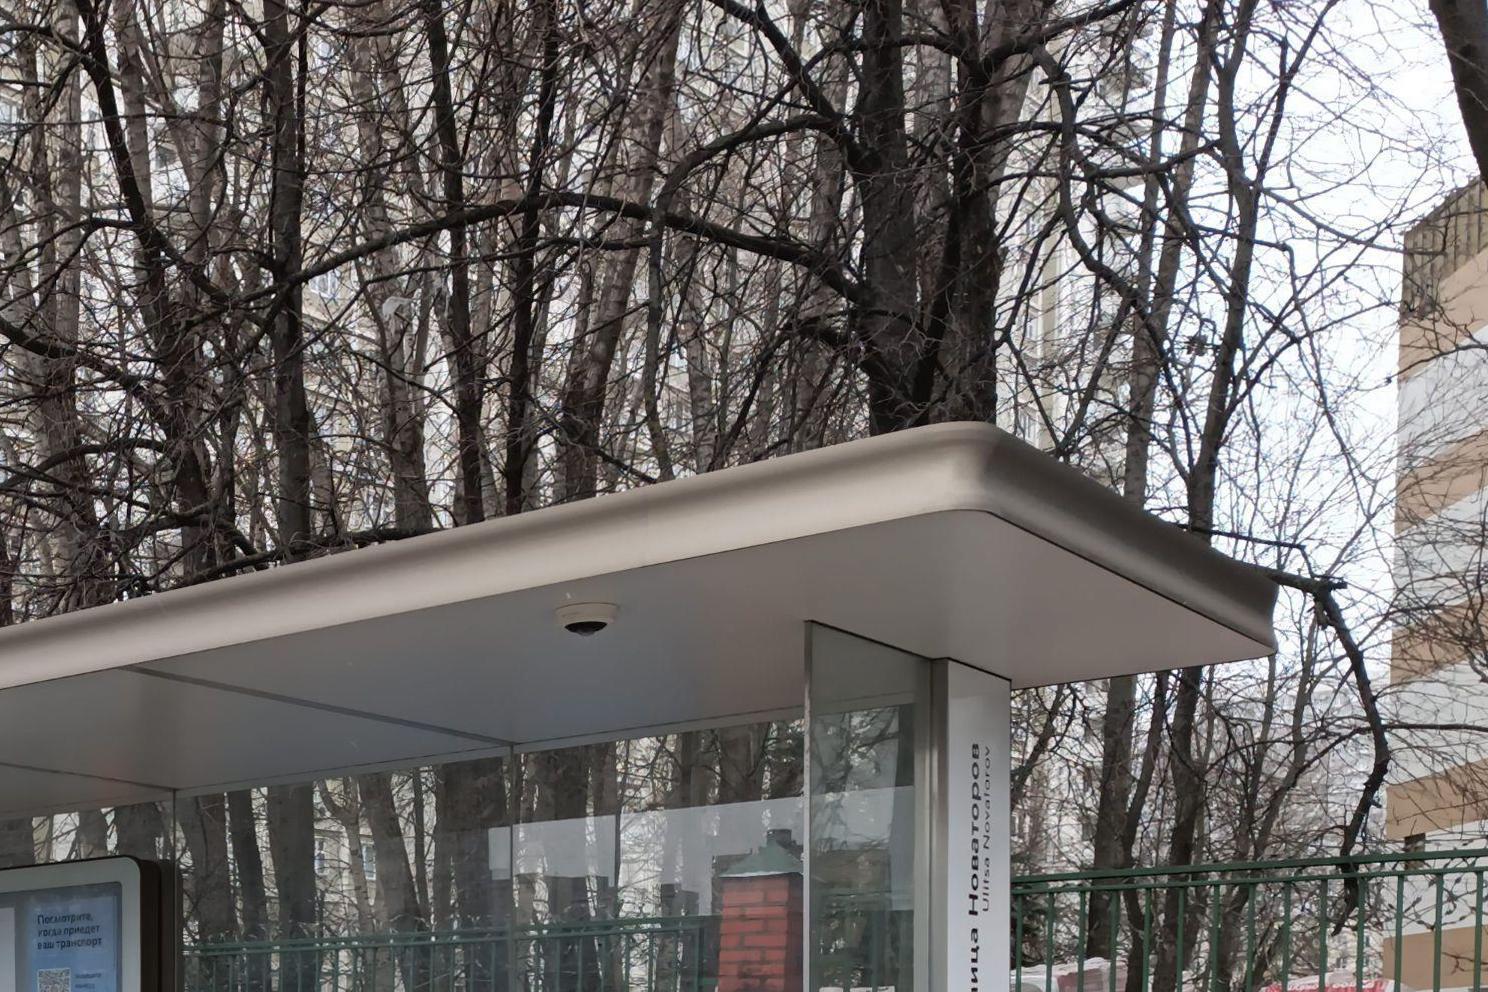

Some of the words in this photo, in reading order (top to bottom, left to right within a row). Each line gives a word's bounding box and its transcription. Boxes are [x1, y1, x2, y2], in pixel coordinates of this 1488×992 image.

[982, 746, 991, 851] Novatorov
[968, 743, 982, 916] Новаторов
[982, 857, 991, 912] Ulitsa
[37, 913, 94, 925] Посмотрите,
[38, 927, 62, 937] когда
[63, 925, 100, 937] приедет
[56, 938, 102, 950] транспорт
